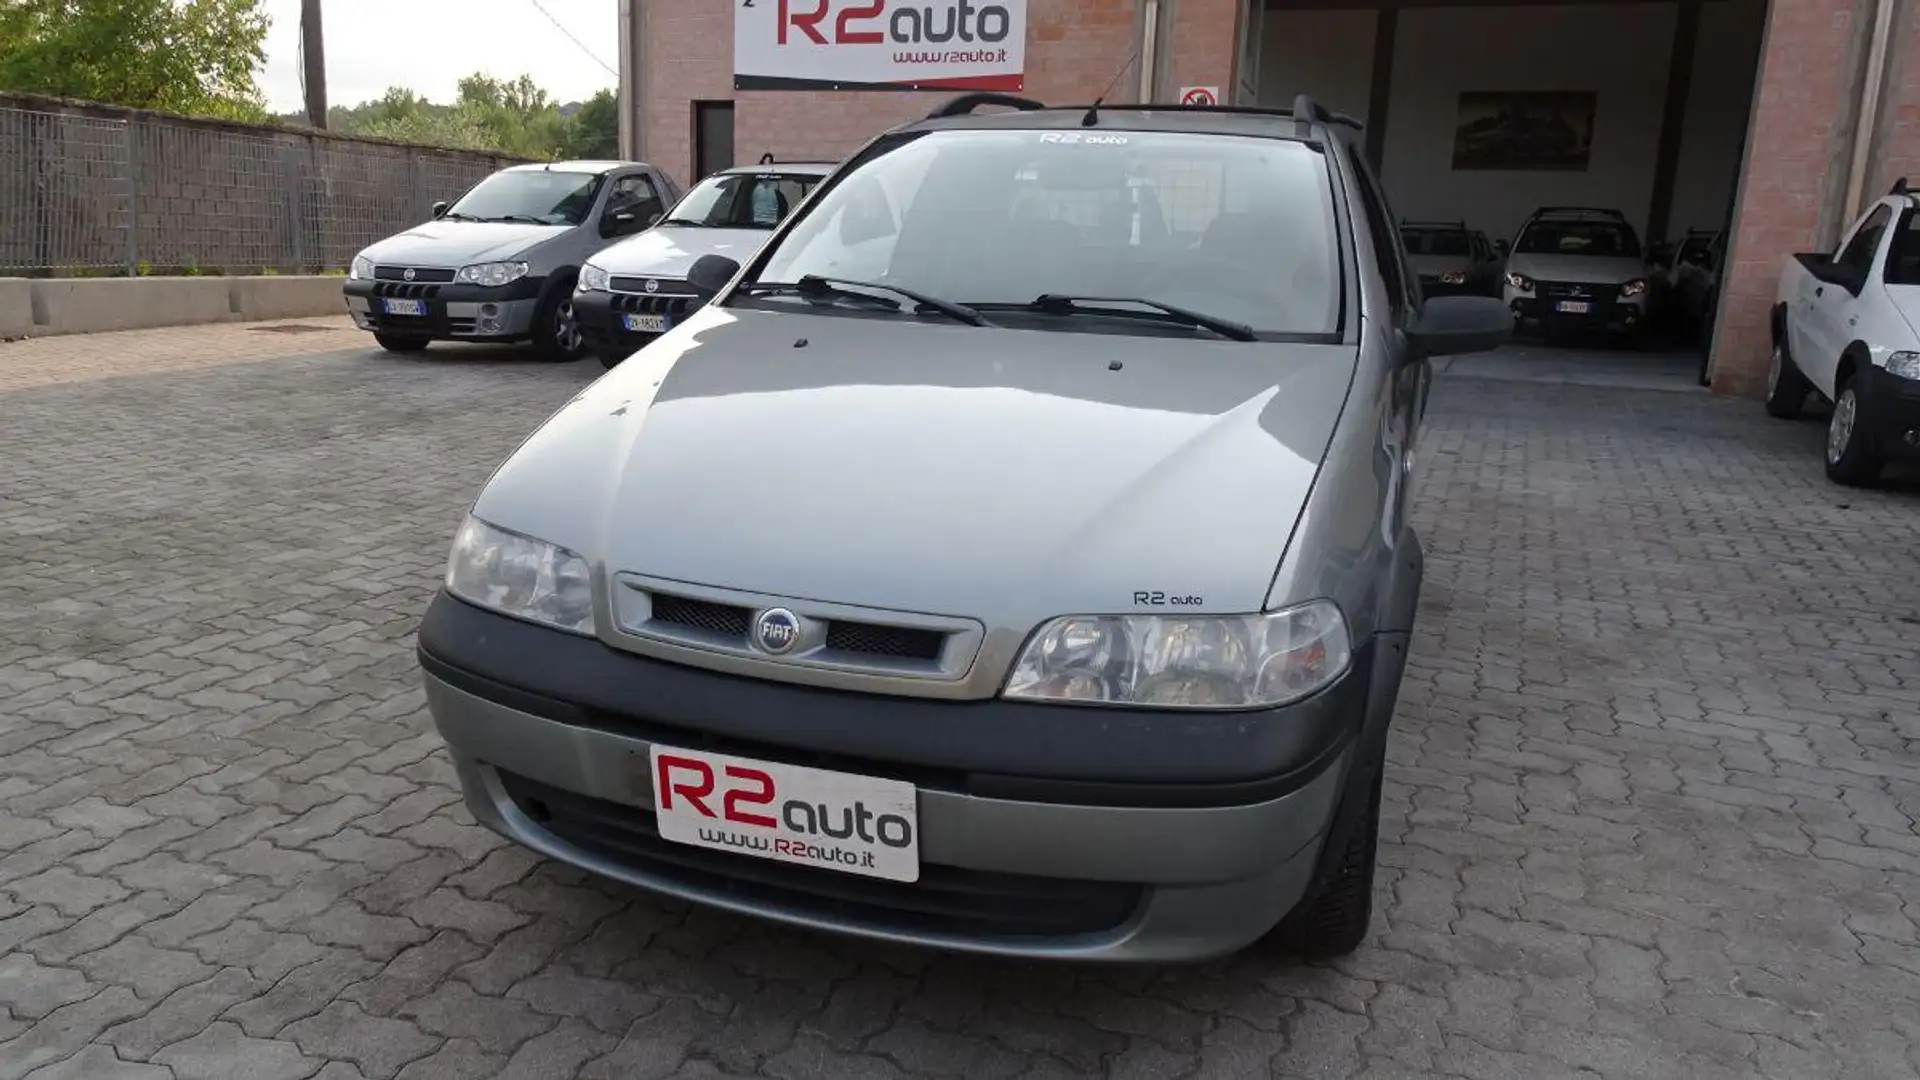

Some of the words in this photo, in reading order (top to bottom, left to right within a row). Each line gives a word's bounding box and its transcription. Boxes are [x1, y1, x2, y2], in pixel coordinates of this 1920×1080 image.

[1039, 132, 1081, 145] R2
[1133, 591, 1166, 606] R2
[1170, 595, 1203, 606] auto
[762, 622, 792, 640] FIAT
[699, 827, 875, 869] www.R2auto.it
